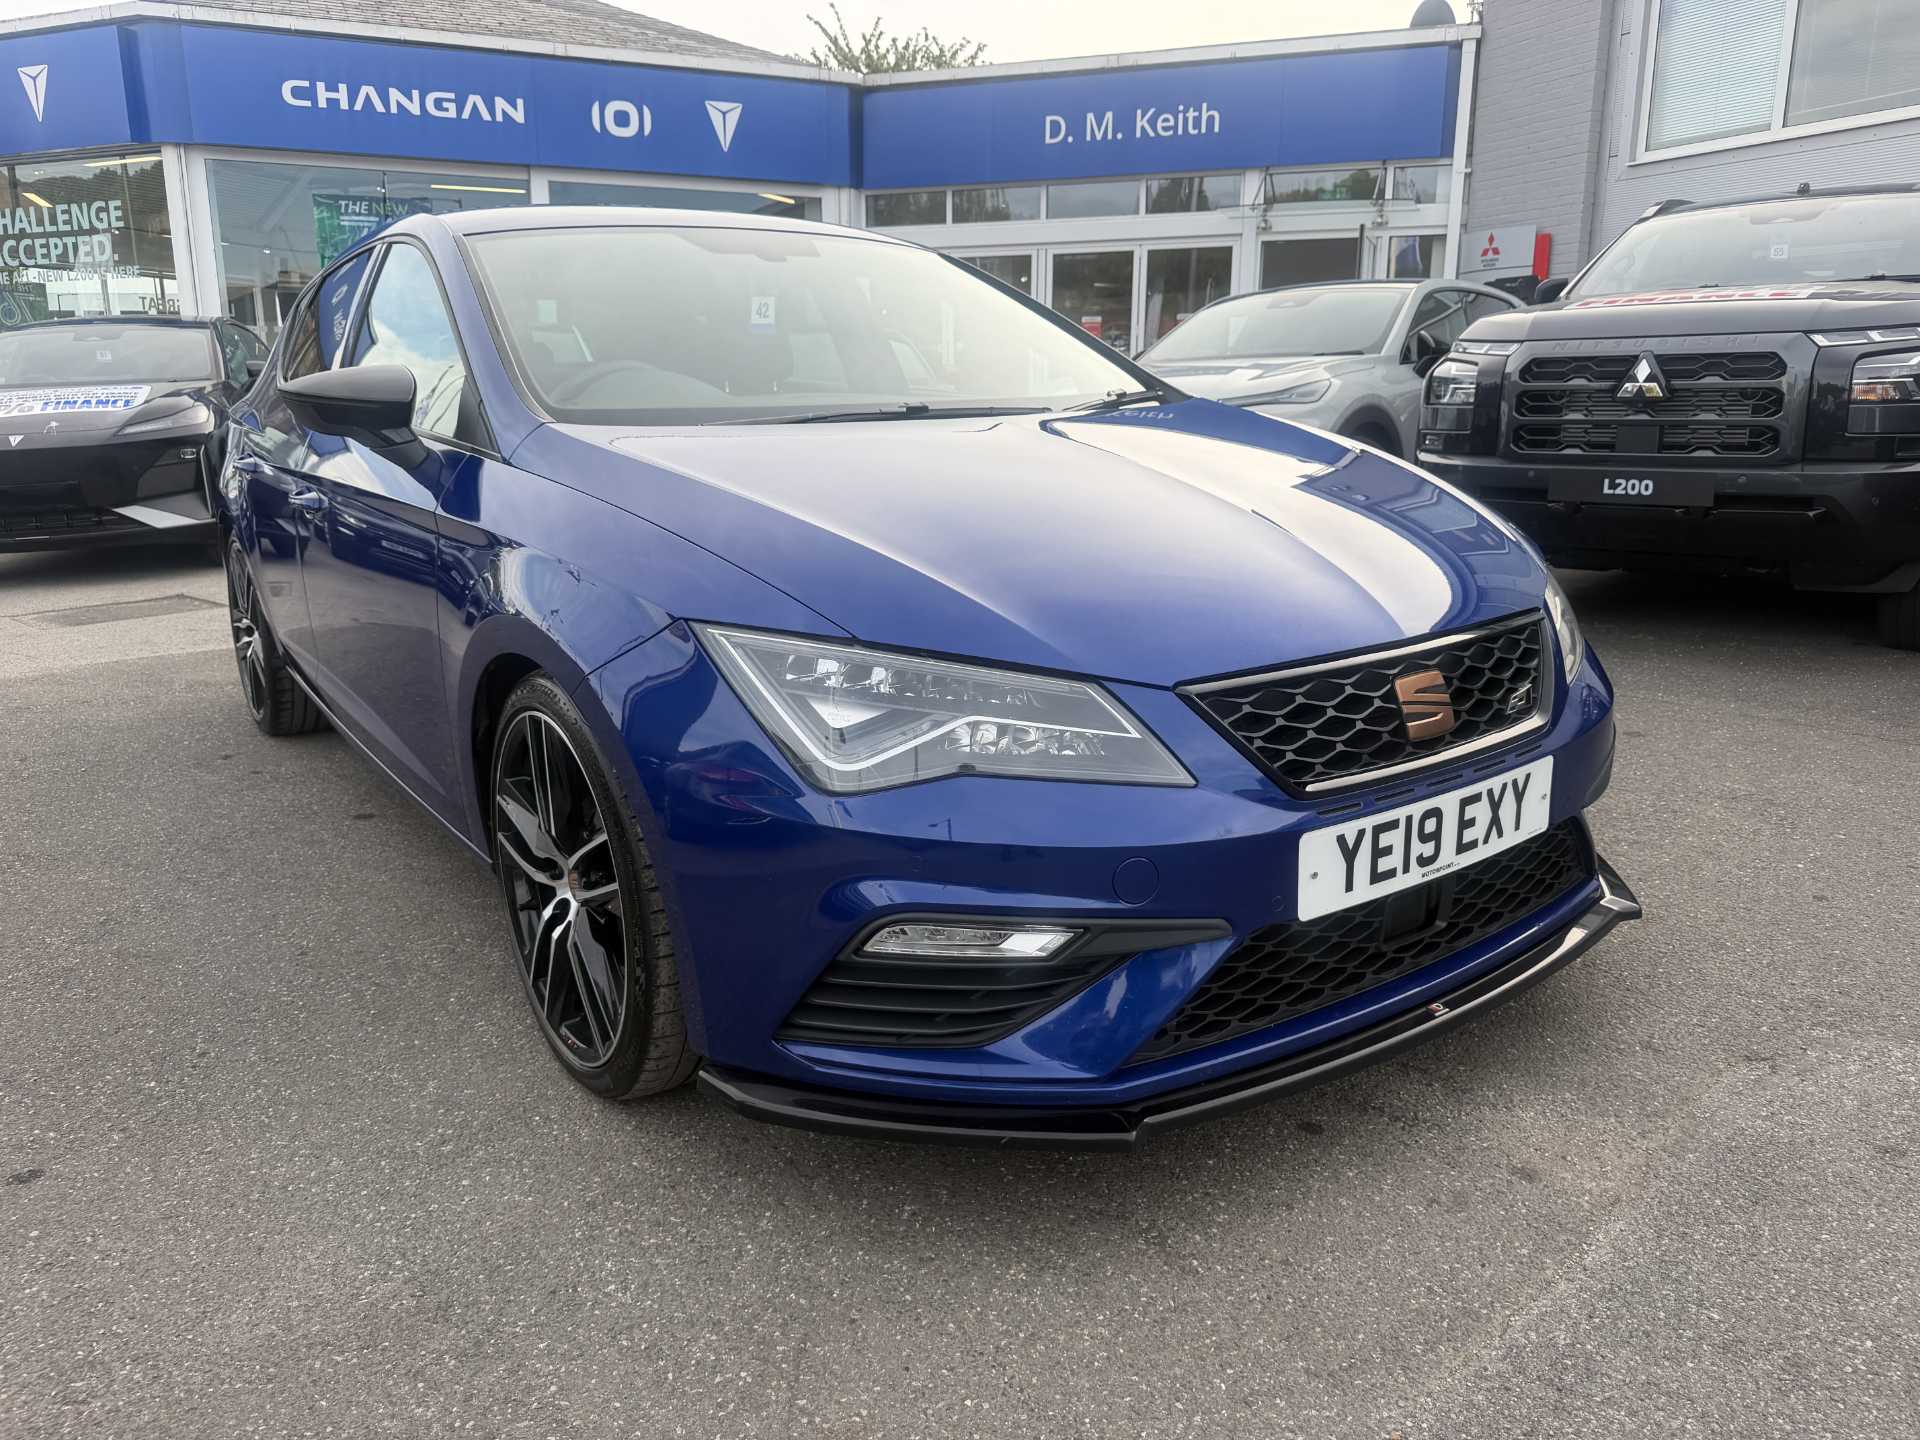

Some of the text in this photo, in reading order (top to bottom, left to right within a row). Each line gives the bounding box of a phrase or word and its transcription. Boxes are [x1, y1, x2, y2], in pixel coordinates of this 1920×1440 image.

[281, 79, 525, 125] CHANGAN
[1044, 102, 1221, 144] D. M. Keith
[0, 199, 125, 235] HALLENGE
[338, 200, 409, 216] THE NEW
[755, 301, 769, 319] 42
[40, 399, 135, 411] FINANCE
[1602, 477, 1654, 496] L200
[1336, 772, 1531, 894] YE19 EXY
